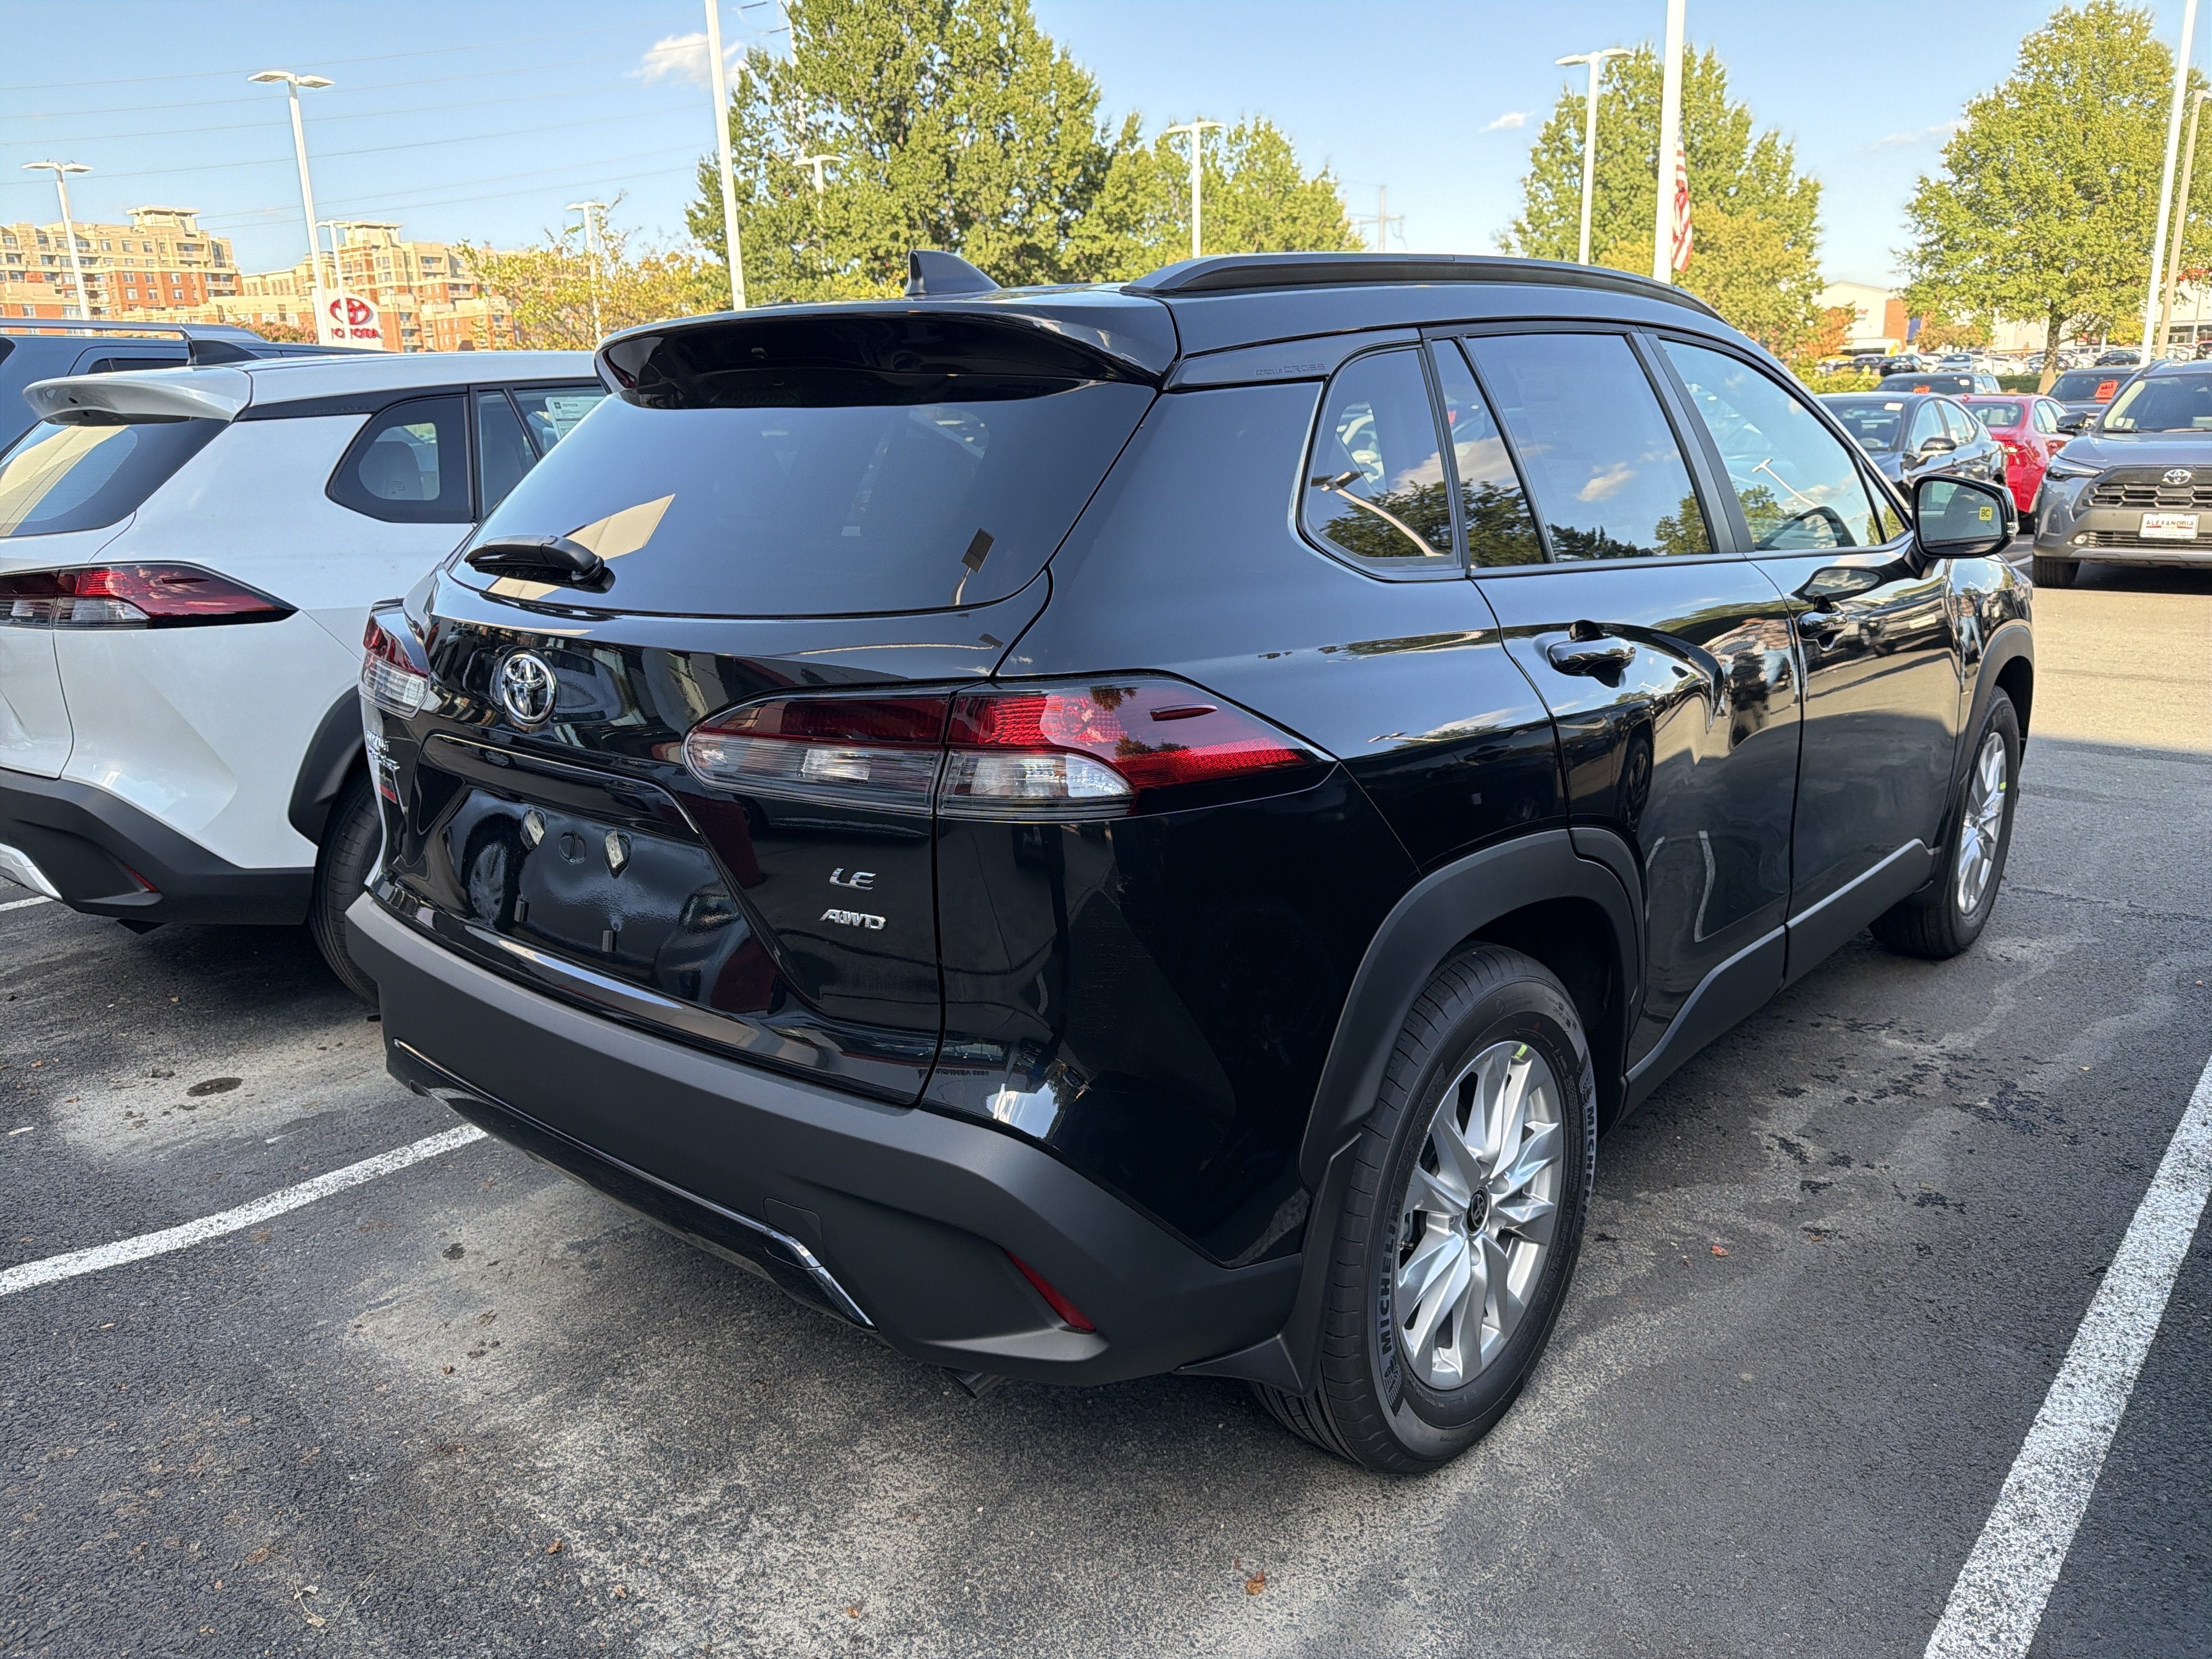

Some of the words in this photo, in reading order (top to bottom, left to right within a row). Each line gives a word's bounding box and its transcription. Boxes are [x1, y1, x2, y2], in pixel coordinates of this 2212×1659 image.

[1283, 364, 1325, 373] CROSS
[1981, 509, 1990, 517] BC
[829, 867, 877, 890] LE
[819, 909, 887, 930] AWD
[1578, 1105, 1595, 1233] MICHELIN
[1379, 1199, 1400, 1356] MICHELIN
